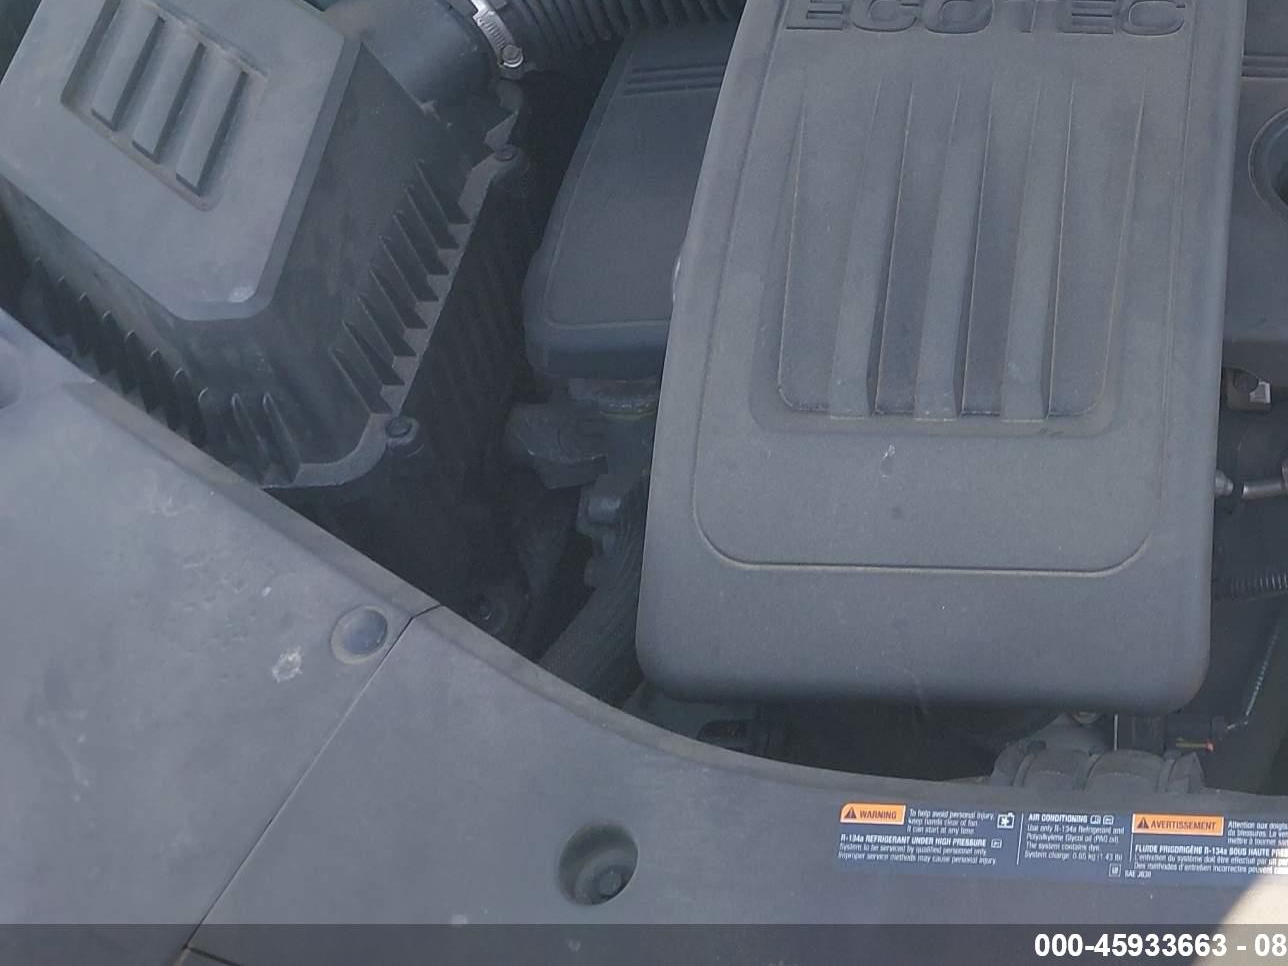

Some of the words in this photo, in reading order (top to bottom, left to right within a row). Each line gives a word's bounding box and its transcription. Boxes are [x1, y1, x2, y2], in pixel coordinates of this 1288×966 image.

[860, 810, 896, 819] WARNING
[910, 808, 916, 816] To
[918, 809, 930, 818] help
[932, 810, 948, 818] avoid
[950, 811, 975, 819] personal
[1029, 813, 1039, 821] AIR
[1042, 814, 1087, 823] CONDITIONING
[908, 817, 922, 826] keep
[924, 818, 942, 826] hands
[960, 819, 966, 827] of
[1151, 820, 1216, 829] AVERTISSEMENT
[1228, 821, 1254, 829] Attention
[1040, 825, 1053, 833] only
[1054, 825, 1076, 833] R-134a
[1078, 826, 1111, 834] Refrigerant
[841, 834, 864, 842] R-134a
[866, 834, 910, 844] REFRIGERANT
[912, 837, 933, 845] UNDER
[935, 837, 951, 845] HIGH
[953, 838, 986, 847] PRESSURE
[1027, 841, 1037, 849] The
[840, 843, 861, 851] System
[880, 844, 905, 852] serviced
[1135, 844, 1157, 853] FLUIDE
[1229, 848, 1246, 856] SOUS
[1249, 848, 1269, 856] HAUTE
[1025, 850, 1047, 859] System
